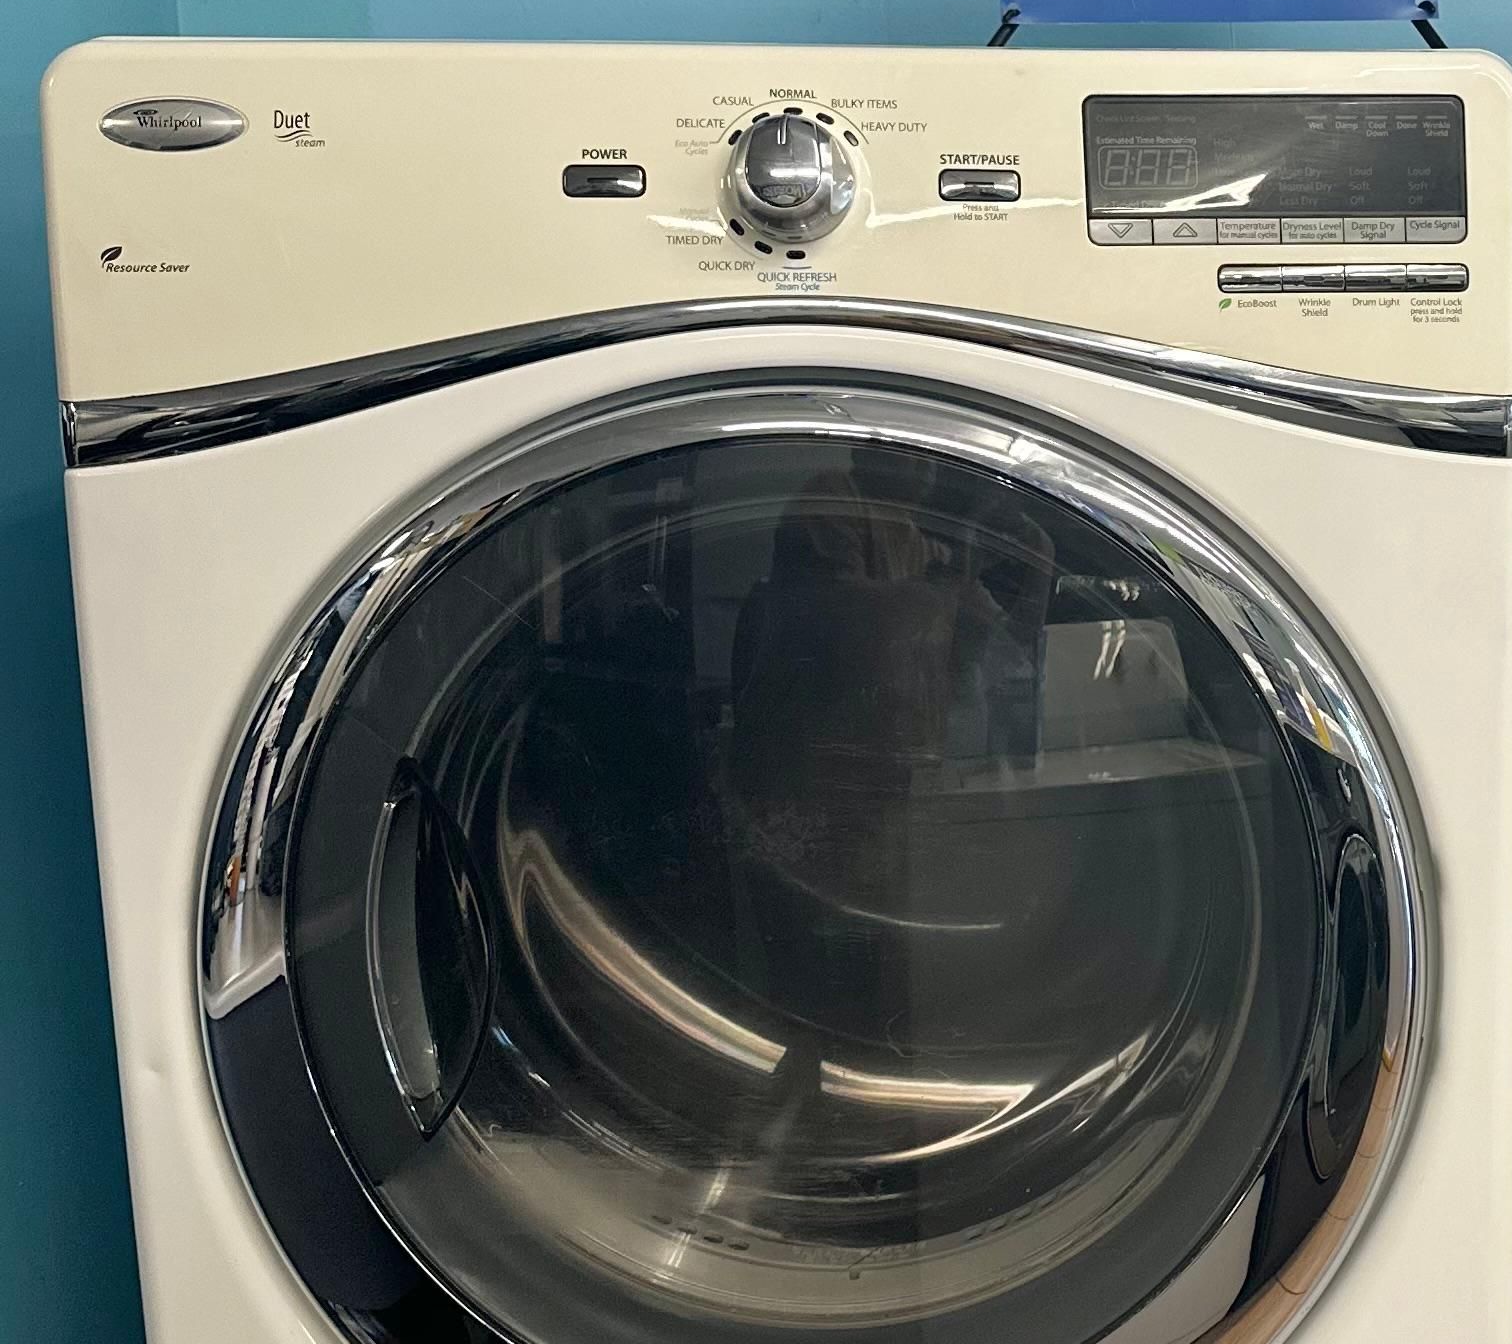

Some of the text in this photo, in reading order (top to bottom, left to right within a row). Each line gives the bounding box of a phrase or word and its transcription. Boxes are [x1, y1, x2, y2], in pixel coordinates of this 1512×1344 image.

[769, 89, 817, 99] NORMAL
[713, 96, 754, 107] CASUAL
[831, 99, 898, 110] BULKY ITEMS
[136, 115, 202, 130] Whirlpool
[273, 110, 311, 129] Duet
[676, 118, 725, 129] DELICATE
[861, 122, 927, 133] HEAVY DUTY
[295, 138, 326, 147] steam
[582, 149, 627, 160] POWER
[940, 154, 1020, 166] START/PAUSE
[1220, 222, 1276, 232] Temperature
[1283, 222, 1342, 233] Dryness Level
[1352, 222, 1395, 233] Damp Dry
[1409, 220, 1460, 231] Cycle Signal
[666, 235, 724, 246] TIMED DRY
[1360, 231, 1387, 241] Signal
[105, 262, 190, 273] Resource Saver
[698, 260, 755, 273] QUICK DRY
[757, 272, 837, 284] QUICK REFRESH
[1237, 298, 1277, 308] EcoBoost
[1298, 298, 1331, 308] Wrinkle
[1353, 298, 1400, 308] Drum Light
[1410, 298, 1462, 307] Control Lock
[1302, 308, 1329, 318] Shield
